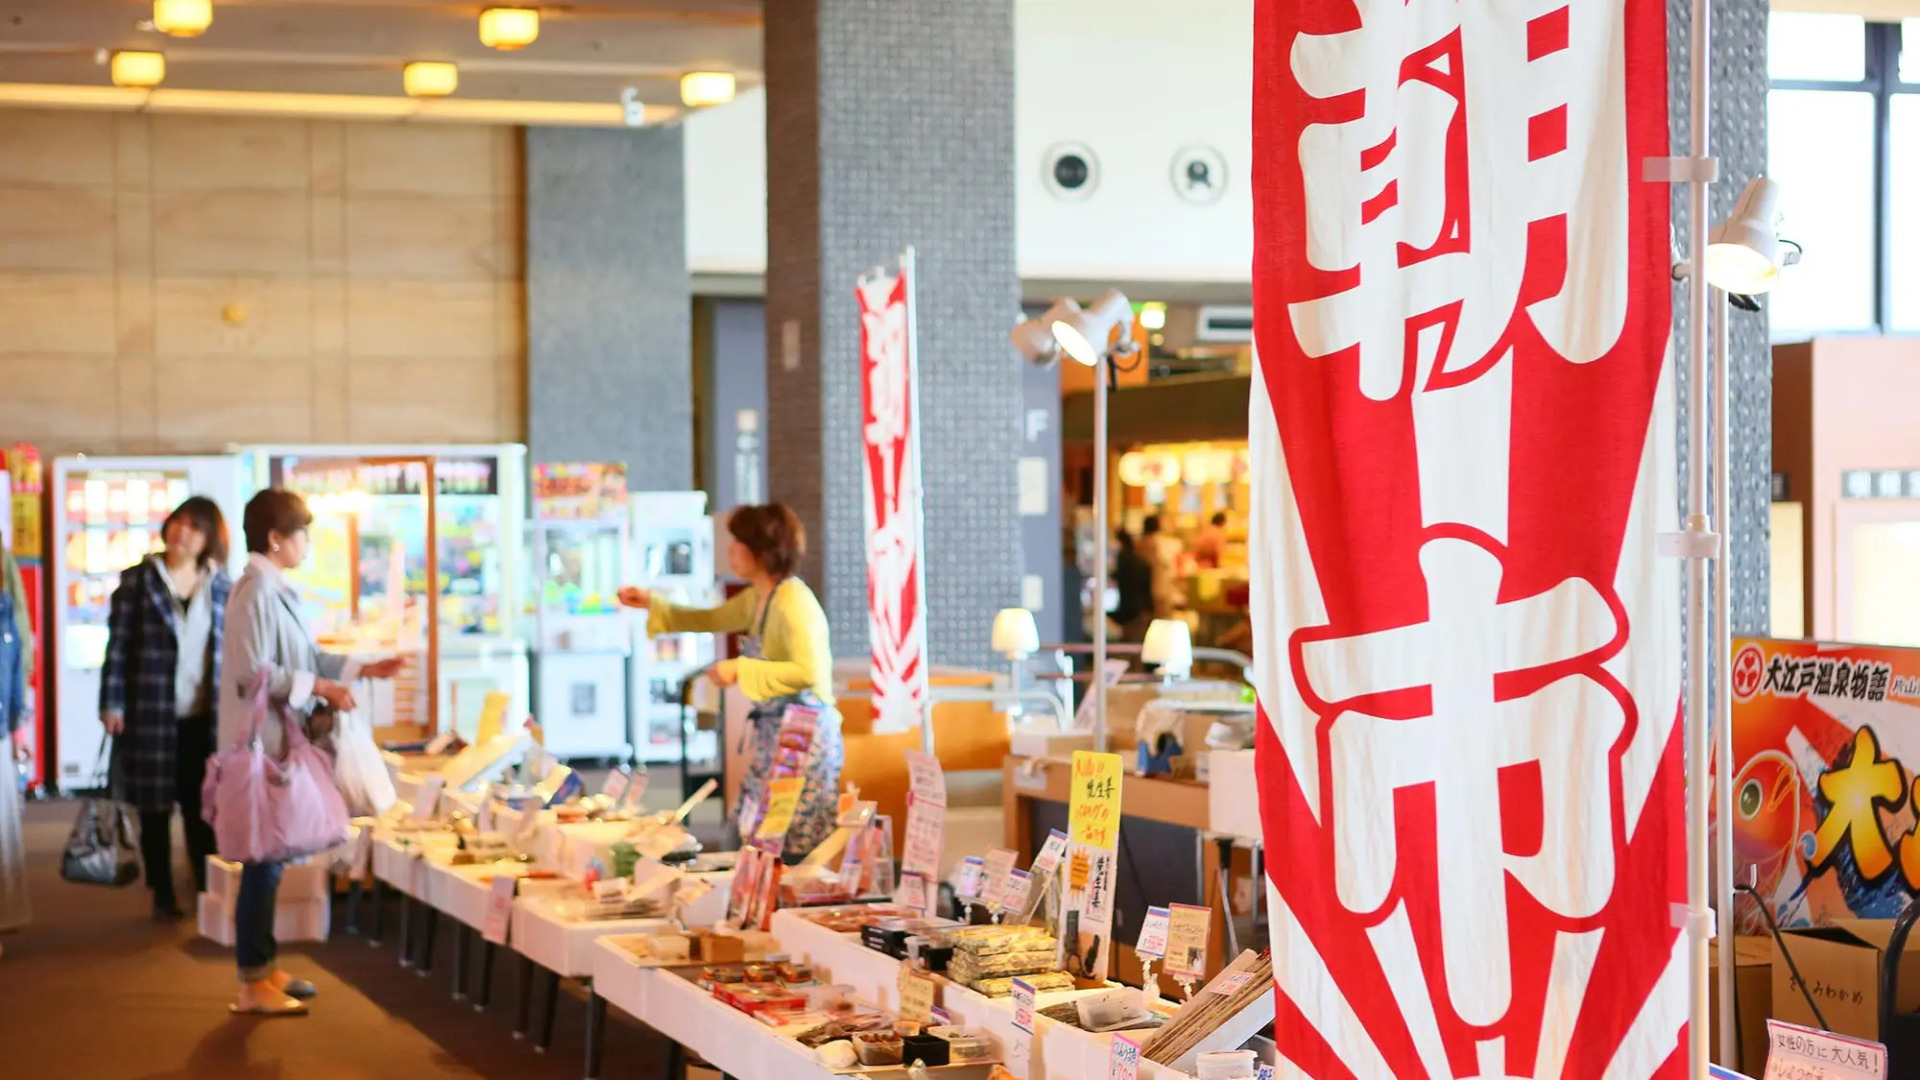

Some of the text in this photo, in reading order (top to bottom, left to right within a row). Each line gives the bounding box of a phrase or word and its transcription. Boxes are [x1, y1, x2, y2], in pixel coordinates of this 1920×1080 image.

[1288, 0, 1628, 1028] 朝市
[1763, 658, 1890, 700] 大江戸温泉物語
[1892, 679, 1920, 696] 片山
[1806, 723, 1920, 895] 大
[1790, 975, 1863, 1004] さみわかめ
